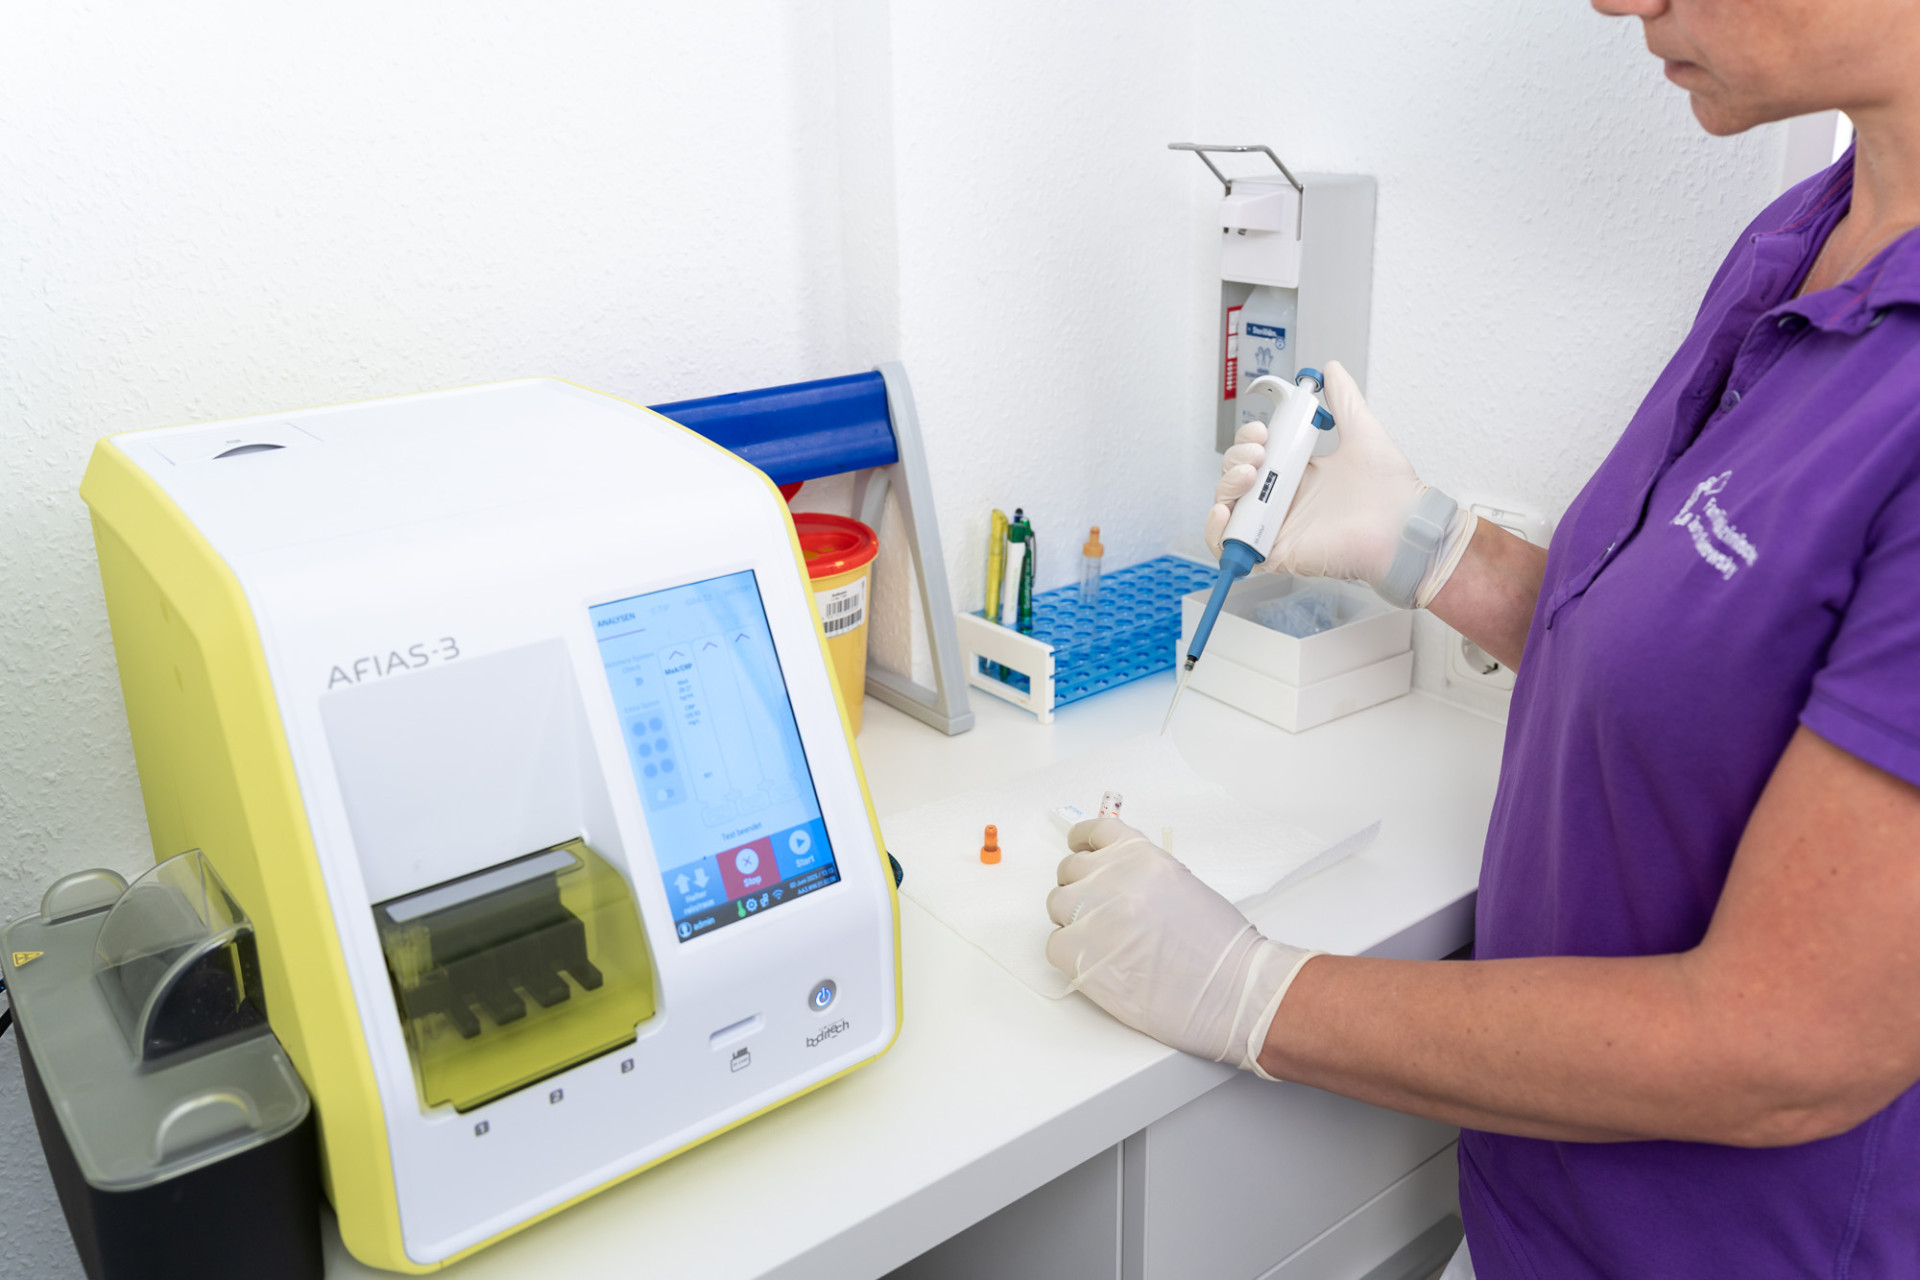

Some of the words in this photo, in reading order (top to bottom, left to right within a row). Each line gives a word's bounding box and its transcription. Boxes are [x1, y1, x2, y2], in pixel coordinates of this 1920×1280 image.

[597, 612, 636, 628] ANALYSEN
[327, 636, 460, 690] AFIAS-3
[722, 831, 737, 841] Test
[736, 821, 763, 836] beendet
[795, 854, 815, 868] Start
[743, 874, 762, 888] Stop
[693, 916, 716, 931] admin
